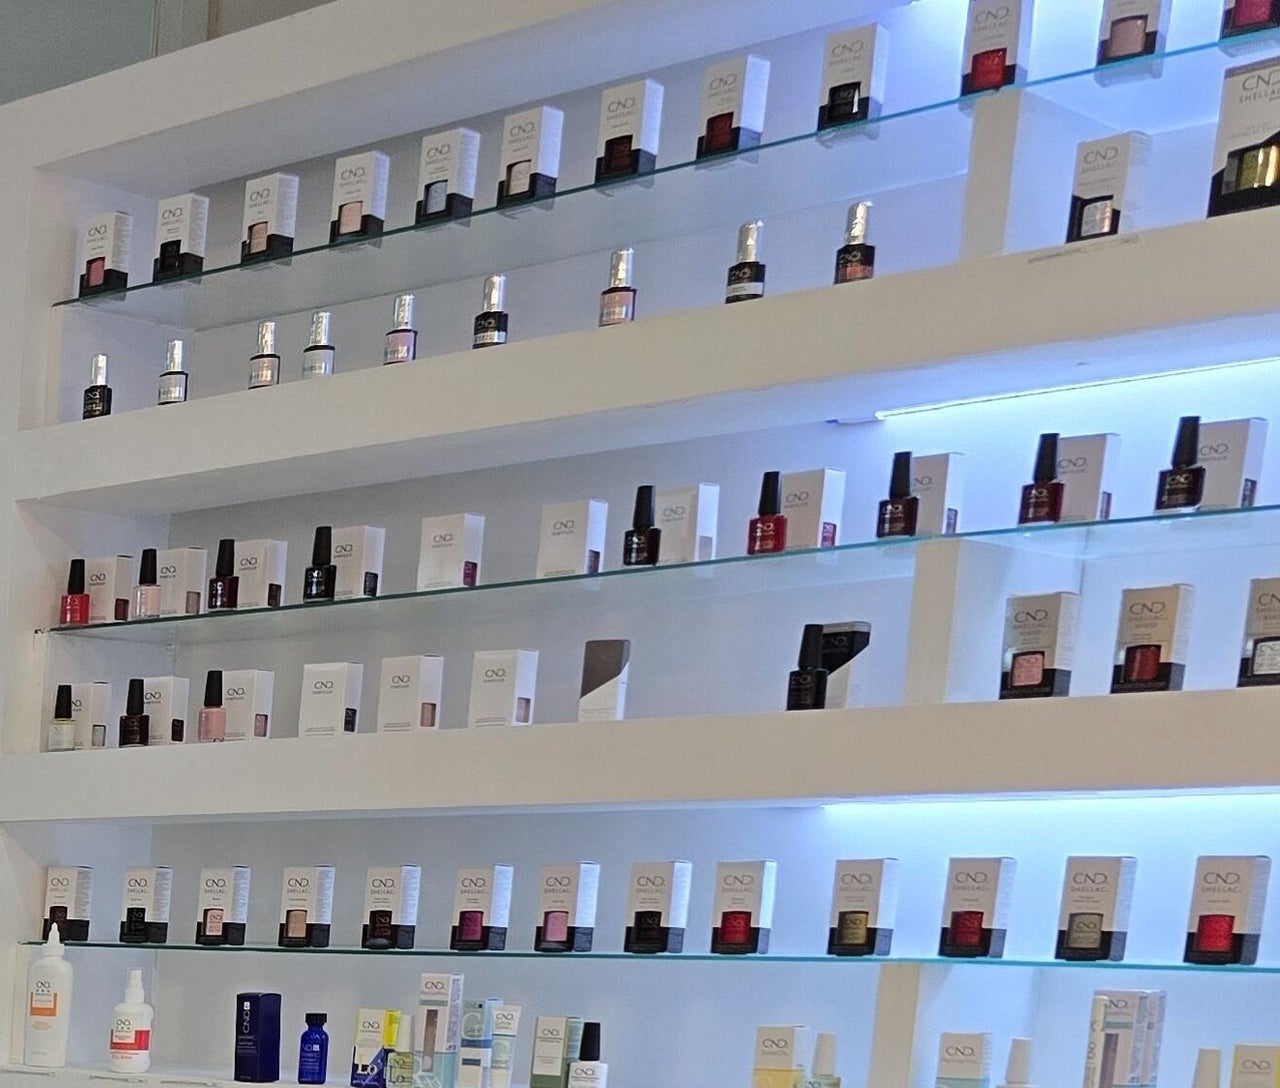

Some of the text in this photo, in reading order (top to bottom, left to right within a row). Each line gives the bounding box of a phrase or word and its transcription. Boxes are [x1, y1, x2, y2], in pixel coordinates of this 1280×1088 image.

[1083, 147, 1119, 165] CND
[1129, 601, 1168, 616] CND
[1013, 609, 1049, 625] CND
[955, 871, 989, 884] CND
[1072, 872, 1109, 886] CND
[1203, 872, 1242, 886] CND
[945, 1046, 976, 1058] CND
